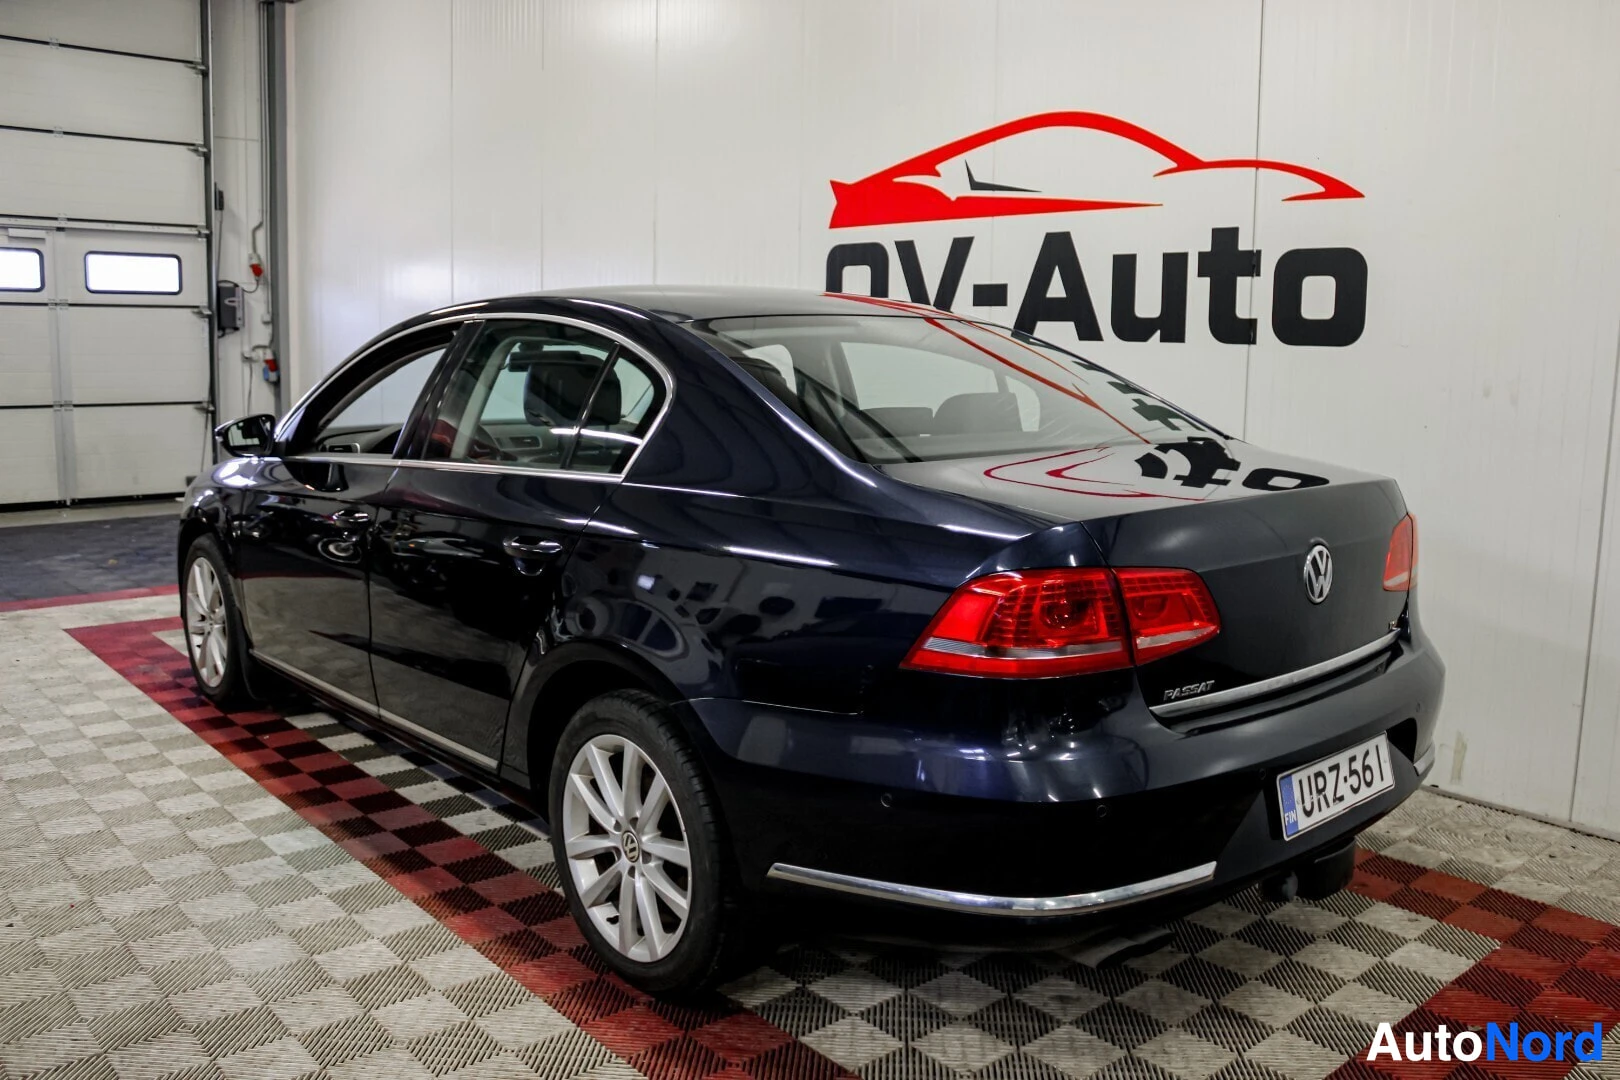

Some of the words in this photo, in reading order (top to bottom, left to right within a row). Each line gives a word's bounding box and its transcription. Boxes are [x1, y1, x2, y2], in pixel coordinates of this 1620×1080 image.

[1163, 679, 1215, 701] PASSAT
[1298, 744, 1384, 818] URZ-561
[1284, 810, 1297, 826] FIN
